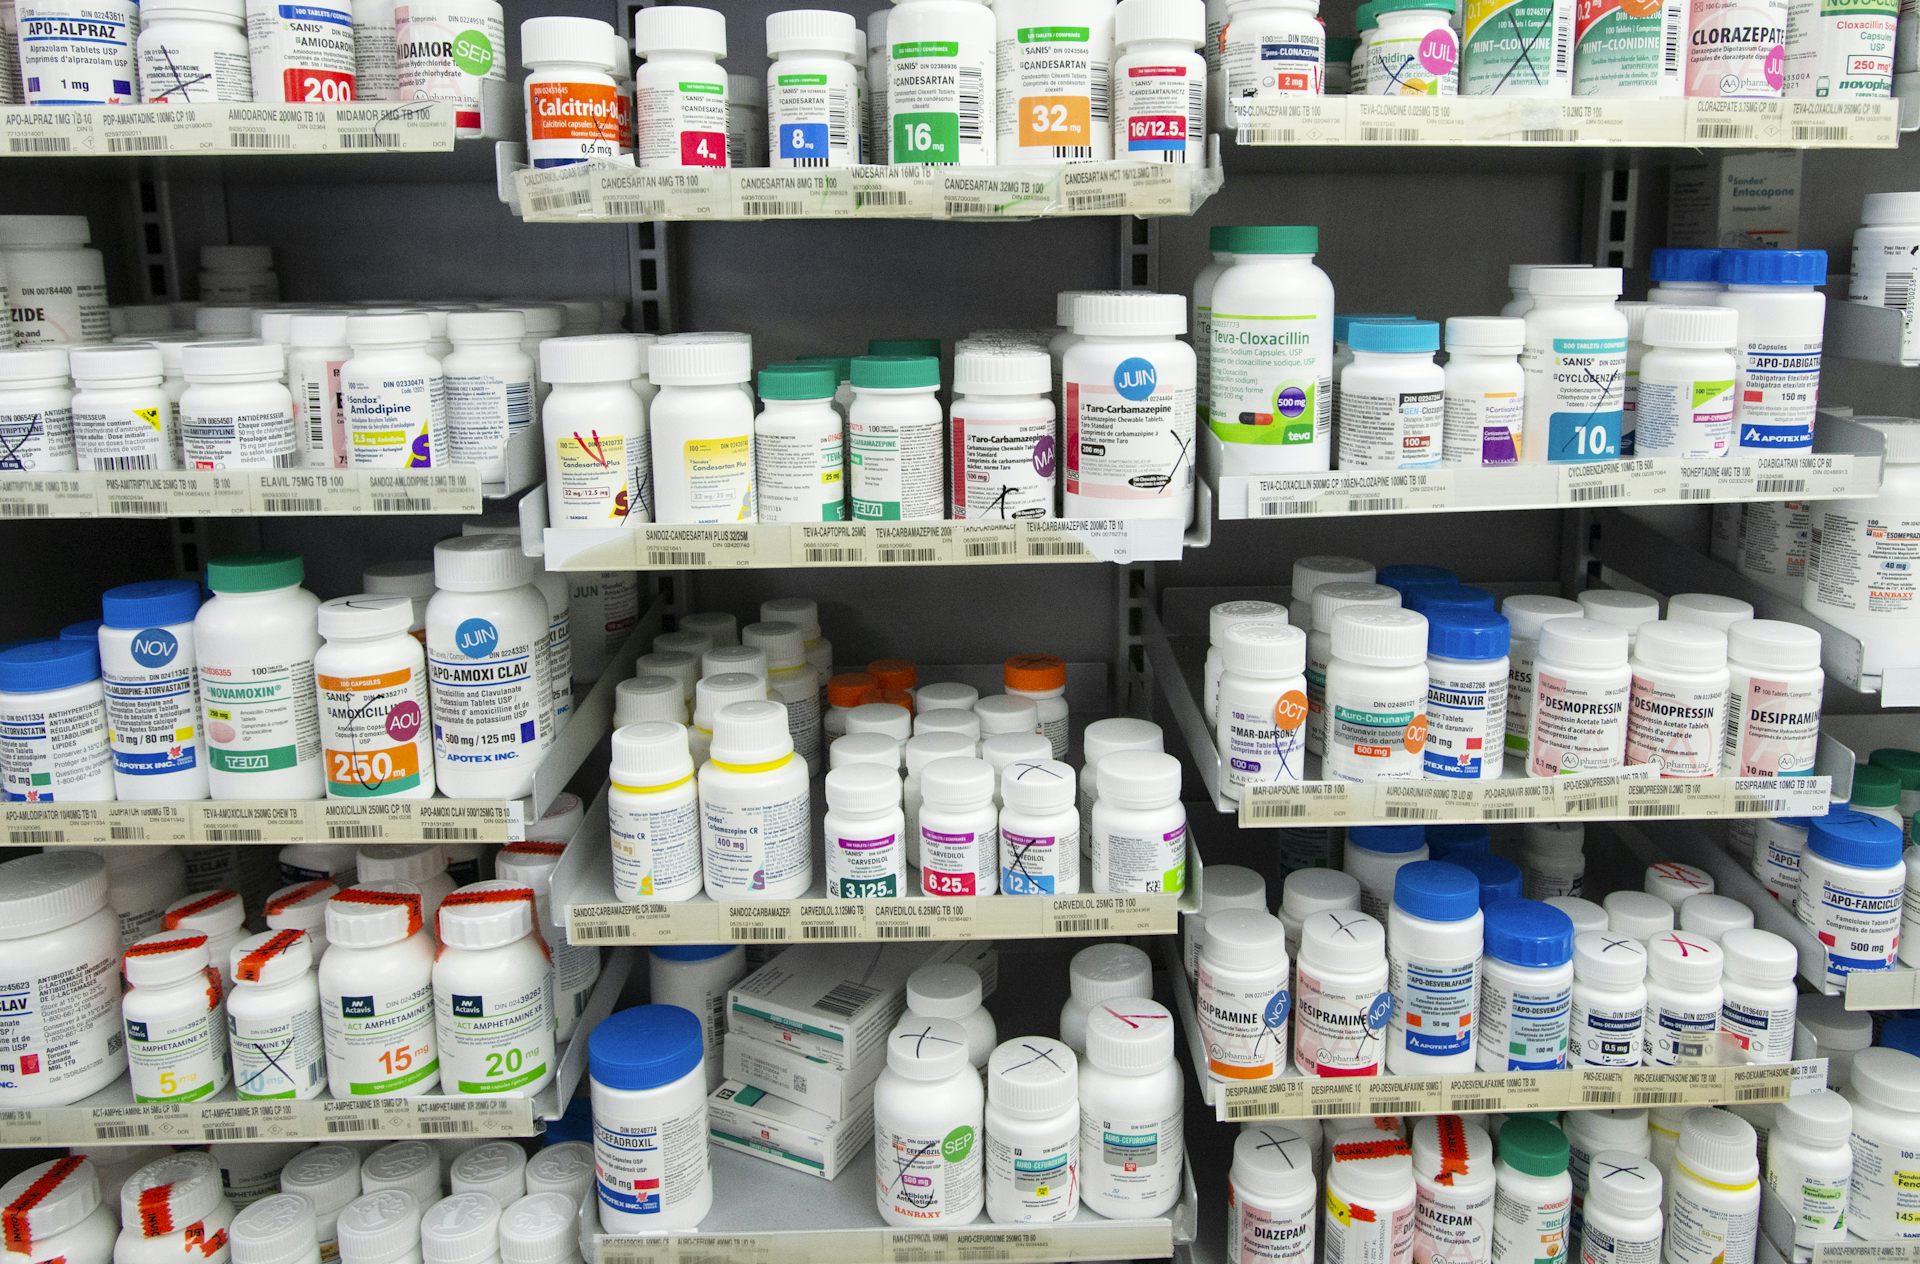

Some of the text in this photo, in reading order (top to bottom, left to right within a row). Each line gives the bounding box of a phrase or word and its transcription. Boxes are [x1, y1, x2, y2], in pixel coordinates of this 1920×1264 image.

[29, 22, 116, 39] APO-ALPRAZ
[1837, 21, 1883, 30] Cloxacillin
[1693, 27, 1784, 46] CLORAZEPATE
[71, 45, 99, 54] Tablets
[455, 40, 491, 64] SEP
[1423, 42, 1453, 62] JUIL
[1024, 60, 1087, 70] CANDESARTAN
[1854, 61, 1874, 69] 250
[61, 80, 89, 92] 1 mg
[896, 76, 955, 87] CANDESARTAN
[304, 78, 351, 101] 200
[782, 97, 825, 105] CANDESARTAN
[1698, 101, 1738, 112] CLORAZEPATE
[229, 109, 302, 122] AMIODARONE 200MG
[336, 110, 430, 121] MIDAMOR TB 100
[1360, 104, 1407, 115] TEVA-CLONIDINE
[6, 114, 53, 125] APO-ALPRAZ
[103, 113, 154, 125] PDP-AMANTADINE
[1032, 106, 1068, 133] 32
[1131, 121, 1178, 137] 16/12.5
[792, 129, 804, 148] 8
[904, 123, 931, 150] 16
[581, 144, 612, 157] 0.5 mcg
[697, 139, 708, 158] 4
[602, 175, 698, 189] CANDESARTAN 4MG 100
[741, 178, 791, 189] CANDESARTAN
[1065, 172, 1108, 185] CANDESARTAN
[944, 179, 1043, 193] CANDESARTAN 32MG 100
[37, 286, 72, 295] 00784400
[1214, 331, 1310, 345] Teva-Cloxacillin
[396, 379, 424, 387] 02330474
[1119, 369, 1155, 388] JUIN
[1279, 398, 1292, 406] 500
[1782, 392, 1795, 401] 150
[351, 404, 411, 414] Amlodipine
[1087, 404, 1171, 414] Taro-Carbamazepine
[1289, 431, 1310, 441] teva
[1575, 426, 1607, 455] 10
[1761, 434, 1799, 443] APOTEX
[1568, 463, 1619, 478] CYCLOBENZAPRINE
[261, 476, 343, 488] ELAVIL 75MG 100
[1260, 479, 1312, 491] TEVA-CLOXACILLIN
[803, 527, 850, 538] TEVA-CAPTOPRIL
[1027, 521, 1107, 532] TEVA-CARBAMAZEPINE 200MG
[646, 530, 728, 541] SANDOZ-CANDESARTAN PLUS
[574, 585, 598, 598] JUN
[1870, 591, 1913, 599] RANBAXY
[461, 626, 496, 649] JUIN
[135, 639, 176, 657] NOV
[434, 662, 528, 681] APO-AMOXI CLAV
[1278, 701, 1305, 720] OCT
[1546, 696, 1622, 714] DESMOPRESSIN
[1635, 696, 1714, 718] DESMOPRESSIN
[389, 712, 420, 730] AOU
[1341, 710, 1411, 724] Auro-Darunavir
[145, 734, 174, 744] 80 mg
[445, 732, 515, 746] 500 mg 125 mg
[1237, 728, 1294, 739] MAR-DAPSONE
[52, 741, 76, 750] LIPIDES
[1357, 746, 1387, 756] 600 mg
[447, 751, 519, 763] APOTEX INC.
[120, 761, 175, 770] APOTEX INC.
[335, 753, 406, 781] 250 mg
[1232, 759, 1245, 768] 100
[1746, 765, 1773, 777] 10 mg
[1253, 785, 1319, 795] MAR-DAPSONE 100MG
[1629, 785, 1668, 794] DESMOPRESSIN
[1735, 780, 1796, 790] DESIPRAMINE 10MG
[204, 808, 252, 818] TEVA-AMOXICILLIN
[326, 804, 389, 815] AMOXICILLIN 250MG
[420, 807, 465, 817] APO-AMOXI CLAV
[717, 837, 730, 848] 400
[845, 882, 887, 898] 3.125
[929, 876, 961, 892] 6.25
[801, 906, 834, 916] CARVEDILOL
[1053, 899, 1114, 911] CARVEDILOL 25MG
[876, 906, 941, 917] CARVEDILOL 6.25MG
[1851, 942, 1869, 952] 500
[1411, 975, 1472, 987] APO-DESVENLAFAXINE
[345, 1006, 371, 1014] Actavis
[1268, 996, 1287, 1025] NOV
[1299, 998, 1367, 1025] DESIPRAMINE
[365, 1007, 423, 1029] AMPHETAMINE
[473, 1010, 533, 1030] AMPHETAMINE
[142, 1037, 197, 1052] AMPHETAMINE
[1604, 1044, 1615, 1052] 0.5
[378, 1044, 429, 1074] 15 mg
[485, 1046, 539, 1077] 20 mg
[159, 1072, 177, 1094] 5
[1369, 1082, 1425, 1093] APO-DESVENLAFAXINE
[1226, 1084, 1286, 1097] DESIPRAMINE 25MG
[1105, 1133, 1157, 1143] AURO-CEFUROXIME
[944, 1135, 972, 1155] SEP
[895, 1206, 941, 1222] RANBAXY
[1419, 1204, 1472, 1226] DIAZEPAM
[1895, 1211, 1914, 1222] 145
[1254, 1224, 1306, 1240] DIAZEPAM
